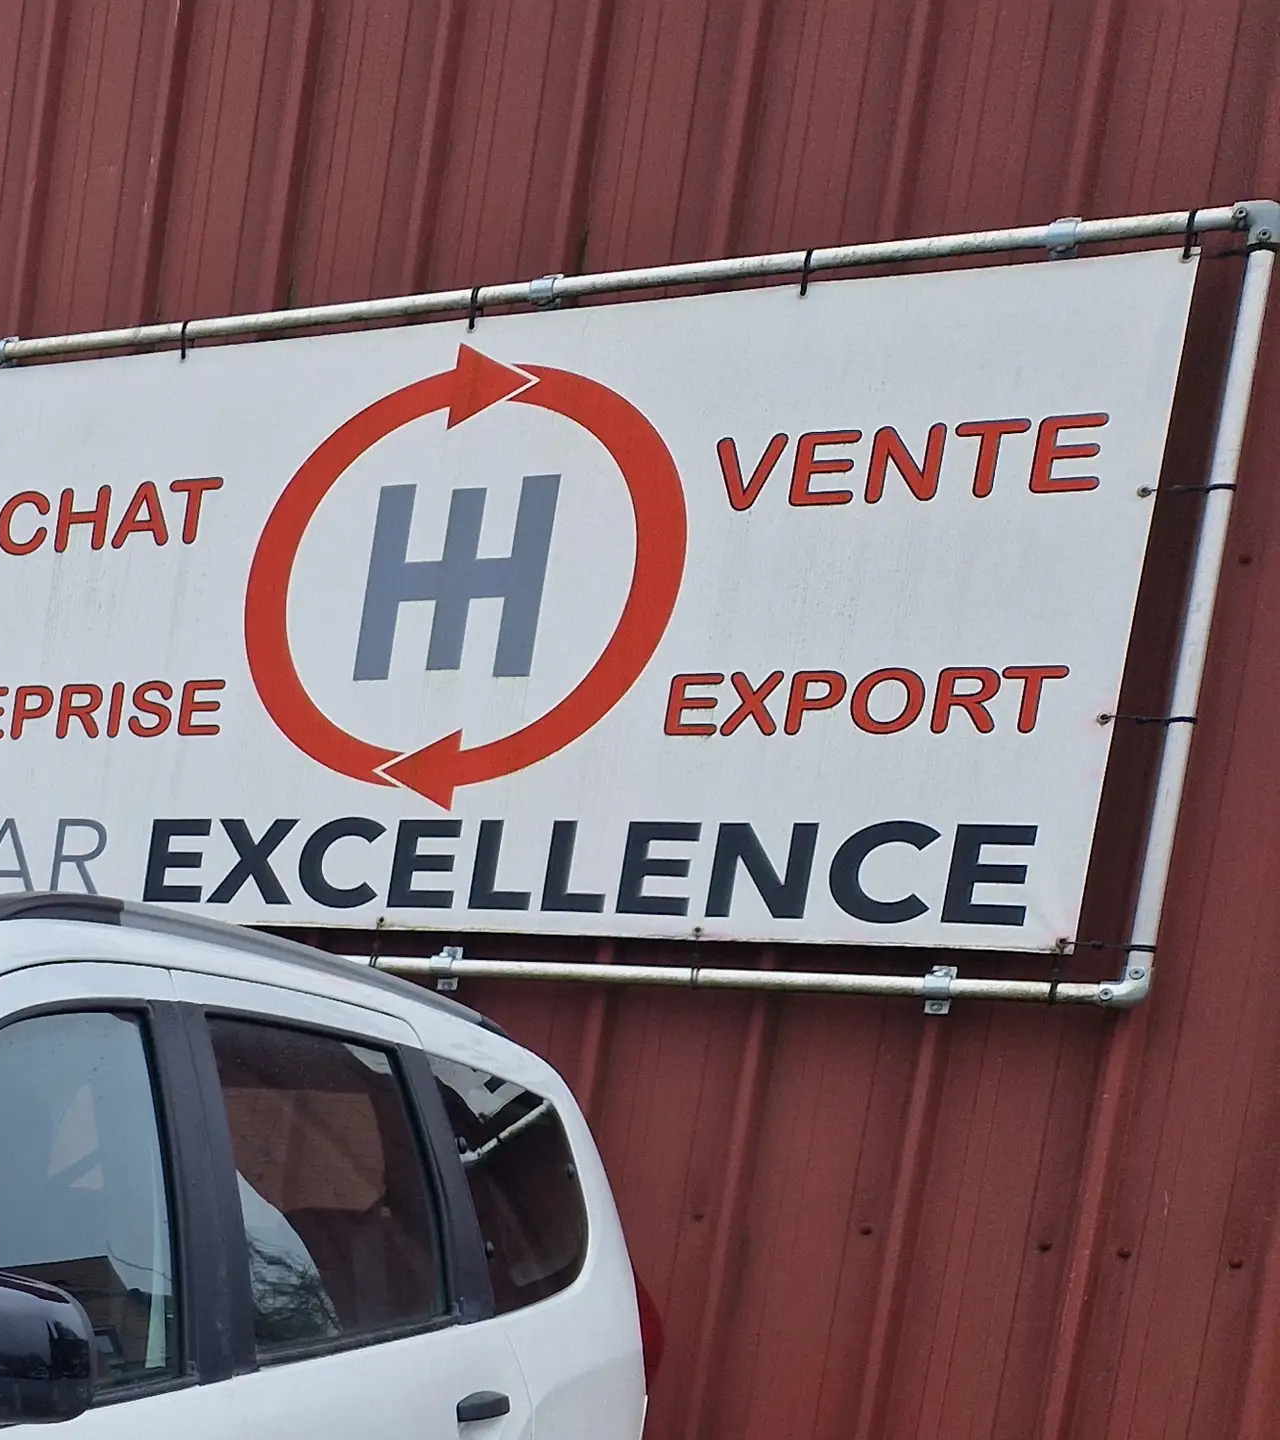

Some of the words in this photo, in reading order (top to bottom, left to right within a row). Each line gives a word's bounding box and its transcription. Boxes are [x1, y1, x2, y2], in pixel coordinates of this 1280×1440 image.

[717, 412, 1109, 511] VENTE
[664, 665, 1070, 736] EXPORT
[143, 817, 1039, 926] EXCELLENCE
